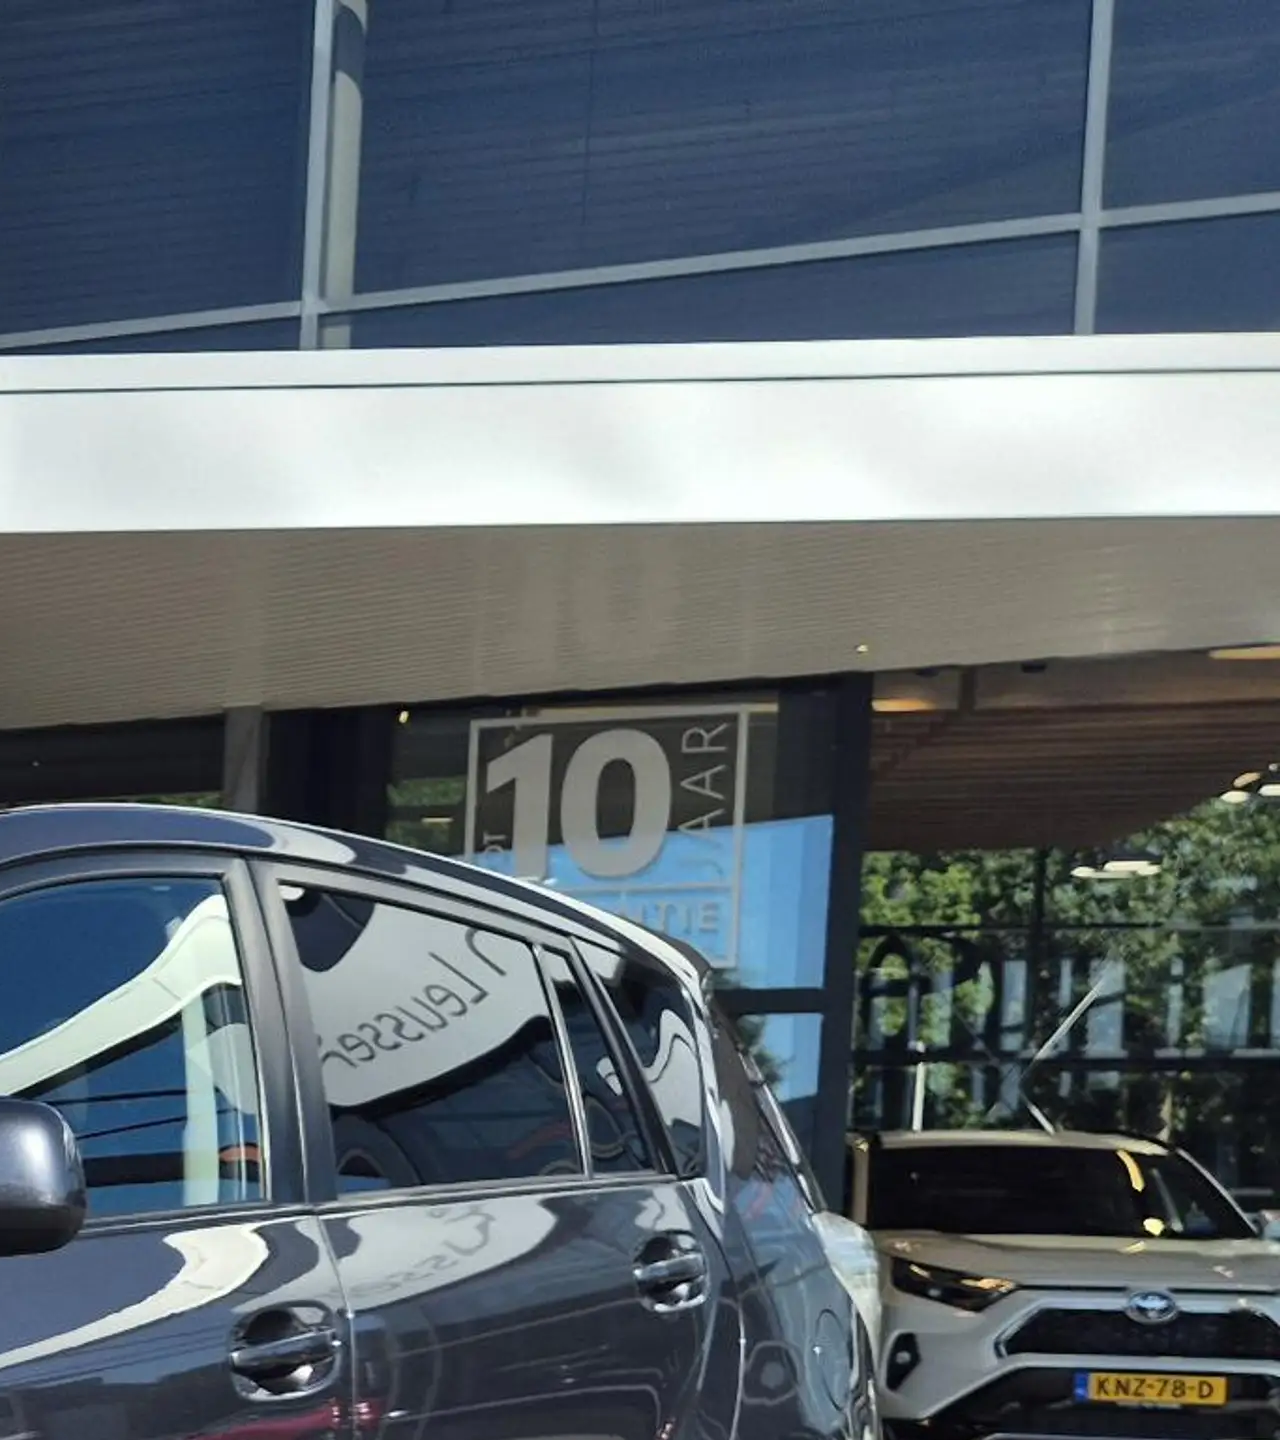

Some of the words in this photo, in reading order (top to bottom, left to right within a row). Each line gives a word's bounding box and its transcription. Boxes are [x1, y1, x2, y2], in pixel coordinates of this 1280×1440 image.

[486, 728, 672, 878] 10
[676, 721, 729, 881] JAAR
[1095, 1376, 1214, 1400] KNZ-78-D
